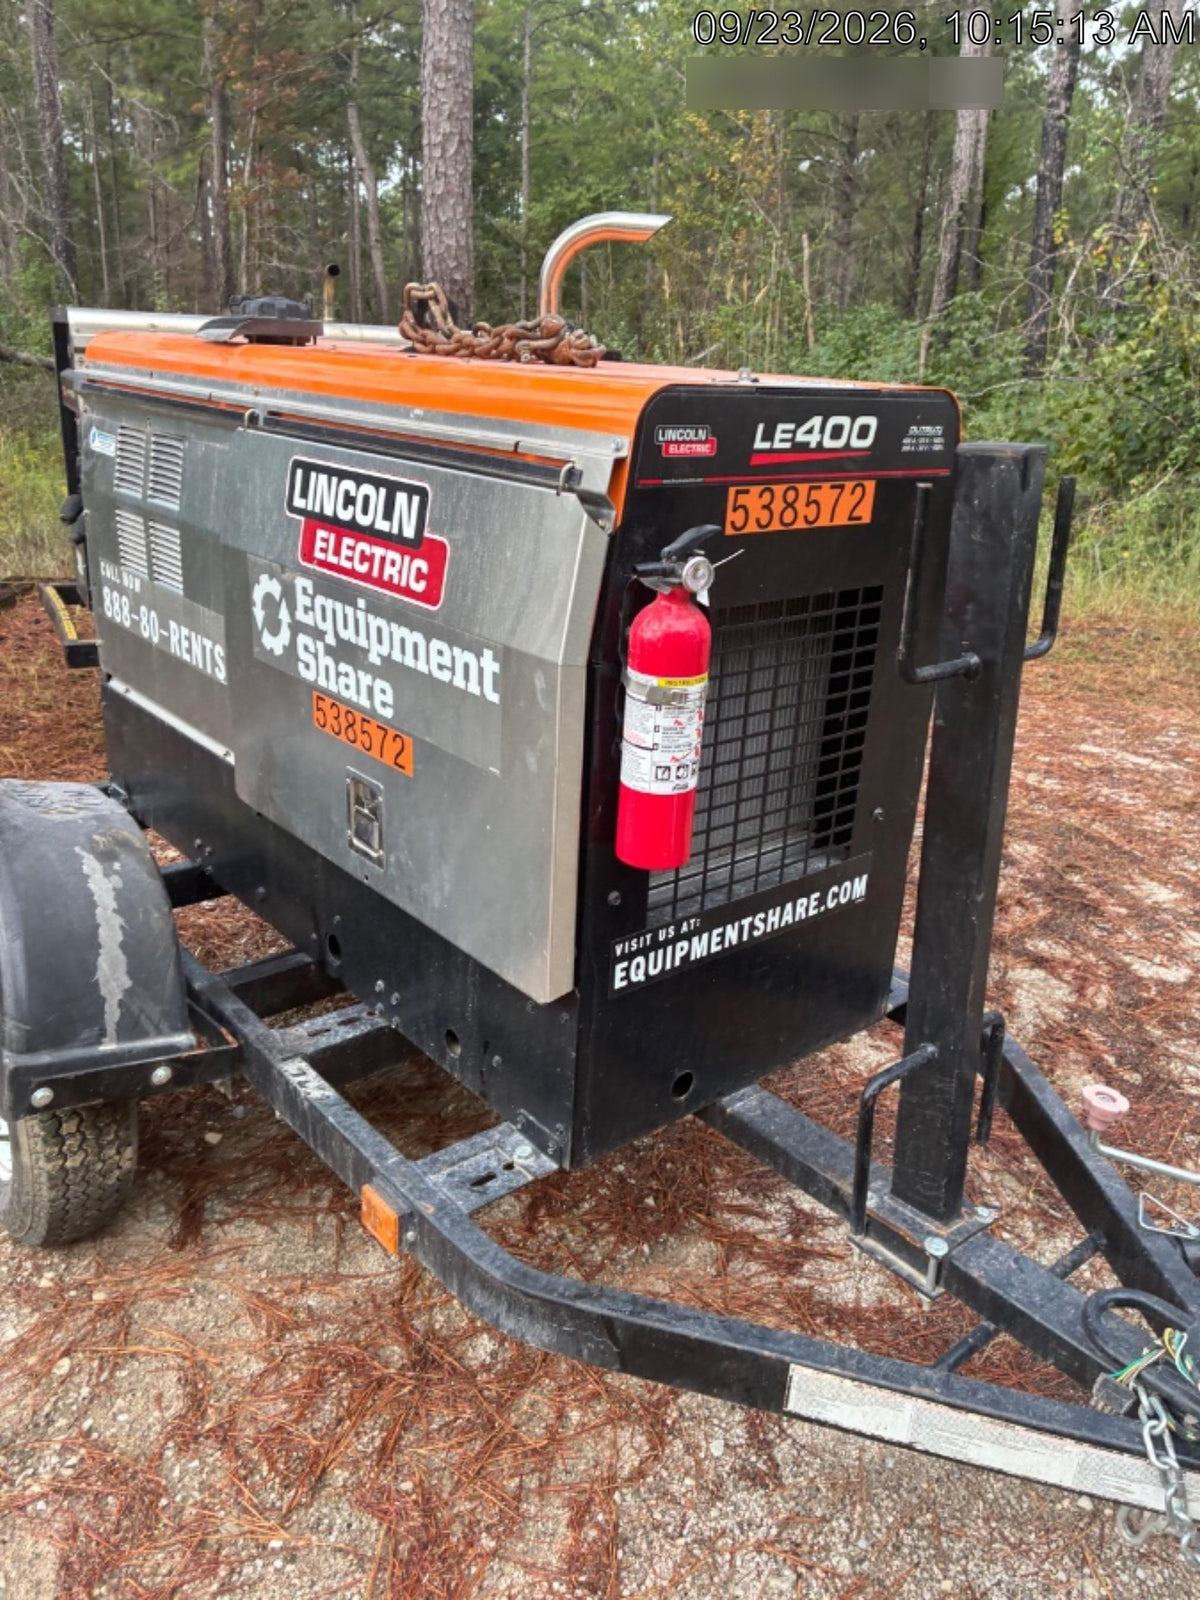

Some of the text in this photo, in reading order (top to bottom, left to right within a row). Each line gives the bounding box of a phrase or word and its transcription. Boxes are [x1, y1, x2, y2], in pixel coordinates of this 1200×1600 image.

[658, 428, 707, 442] LINCOLN
[668, 443, 712, 454] ELECTRIC
[754, 415, 877, 450] LE400
[292, 468, 420, 540] LINCOLN
[730, 482, 867, 533] 538572
[100, 561, 121, 584] CALL
[313, 528, 429, 594] ELECTRIC
[102, 585, 227, 681] 888-80-RENTS
[294, 575, 500, 705] Equipment
[295, 632, 395, 720] Share
[314, 694, 407, 771] 538572
[613, 873, 869, 991] EQUIPMENTSHARE.COM
[614, 917, 701, 958] VISIT US AT:
